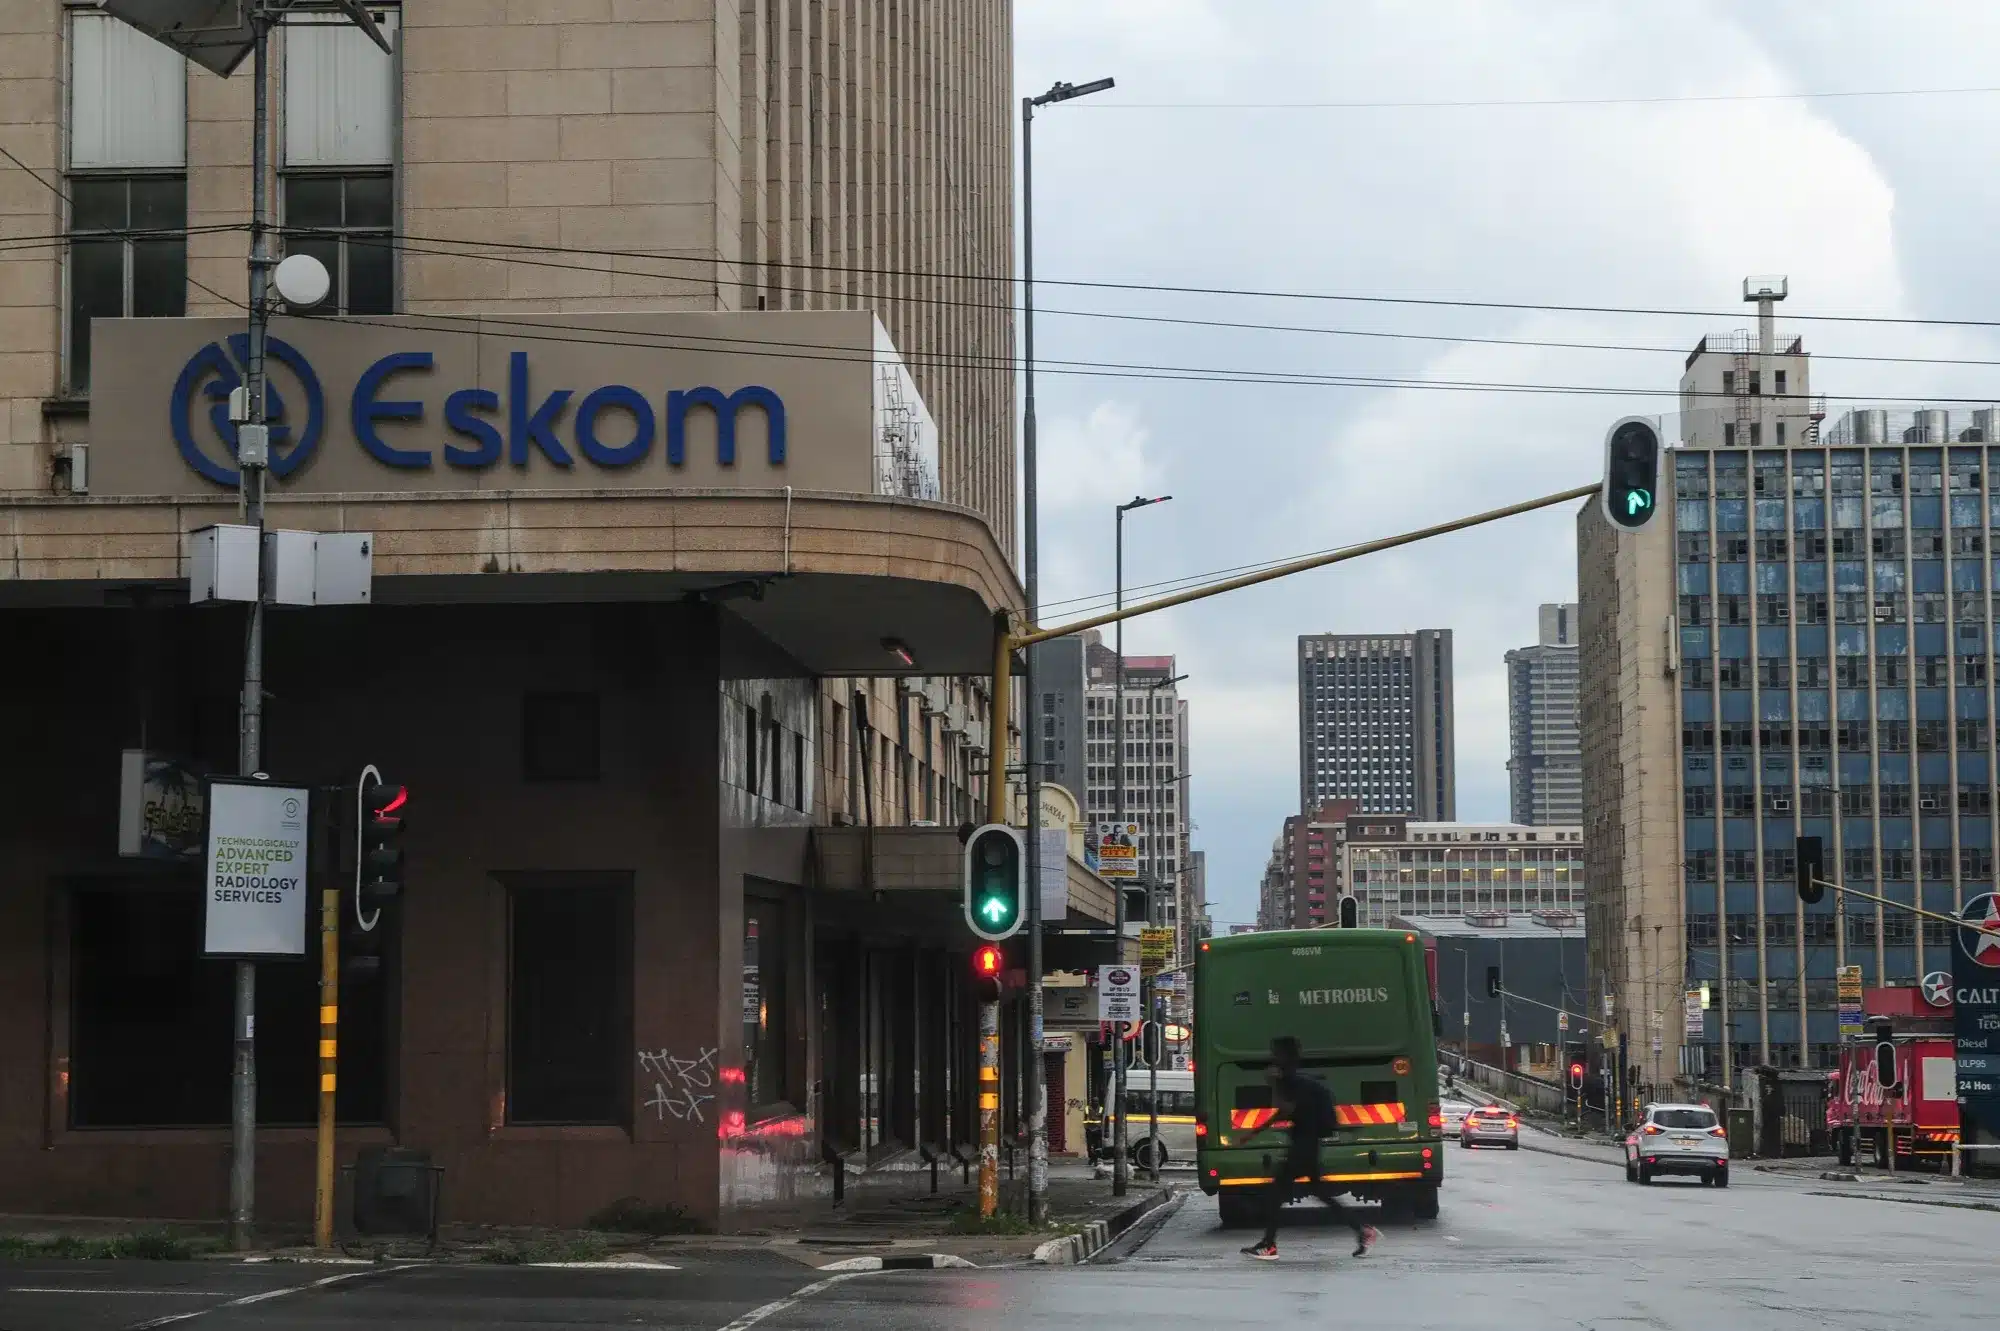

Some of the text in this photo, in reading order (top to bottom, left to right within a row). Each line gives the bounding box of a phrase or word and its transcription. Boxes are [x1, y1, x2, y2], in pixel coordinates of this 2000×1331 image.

[351, 351, 786, 468] Eskom
[216, 836, 300, 848] TECHNOLOGICALLY
[215, 847, 294, 862] ADVANCED
[215, 861, 270, 875] EXPERT
[214, 875, 299, 890] RADIOLOGY
[214, 889, 282, 904] SERVICES
[1298, 987, 1389, 1005] METROBUS
[1958, 1038, 1988, 1048] Diesel
[1958, 1059, 1987, 1068] ULP95
[1959, 1080, 1972, 1090] 24
